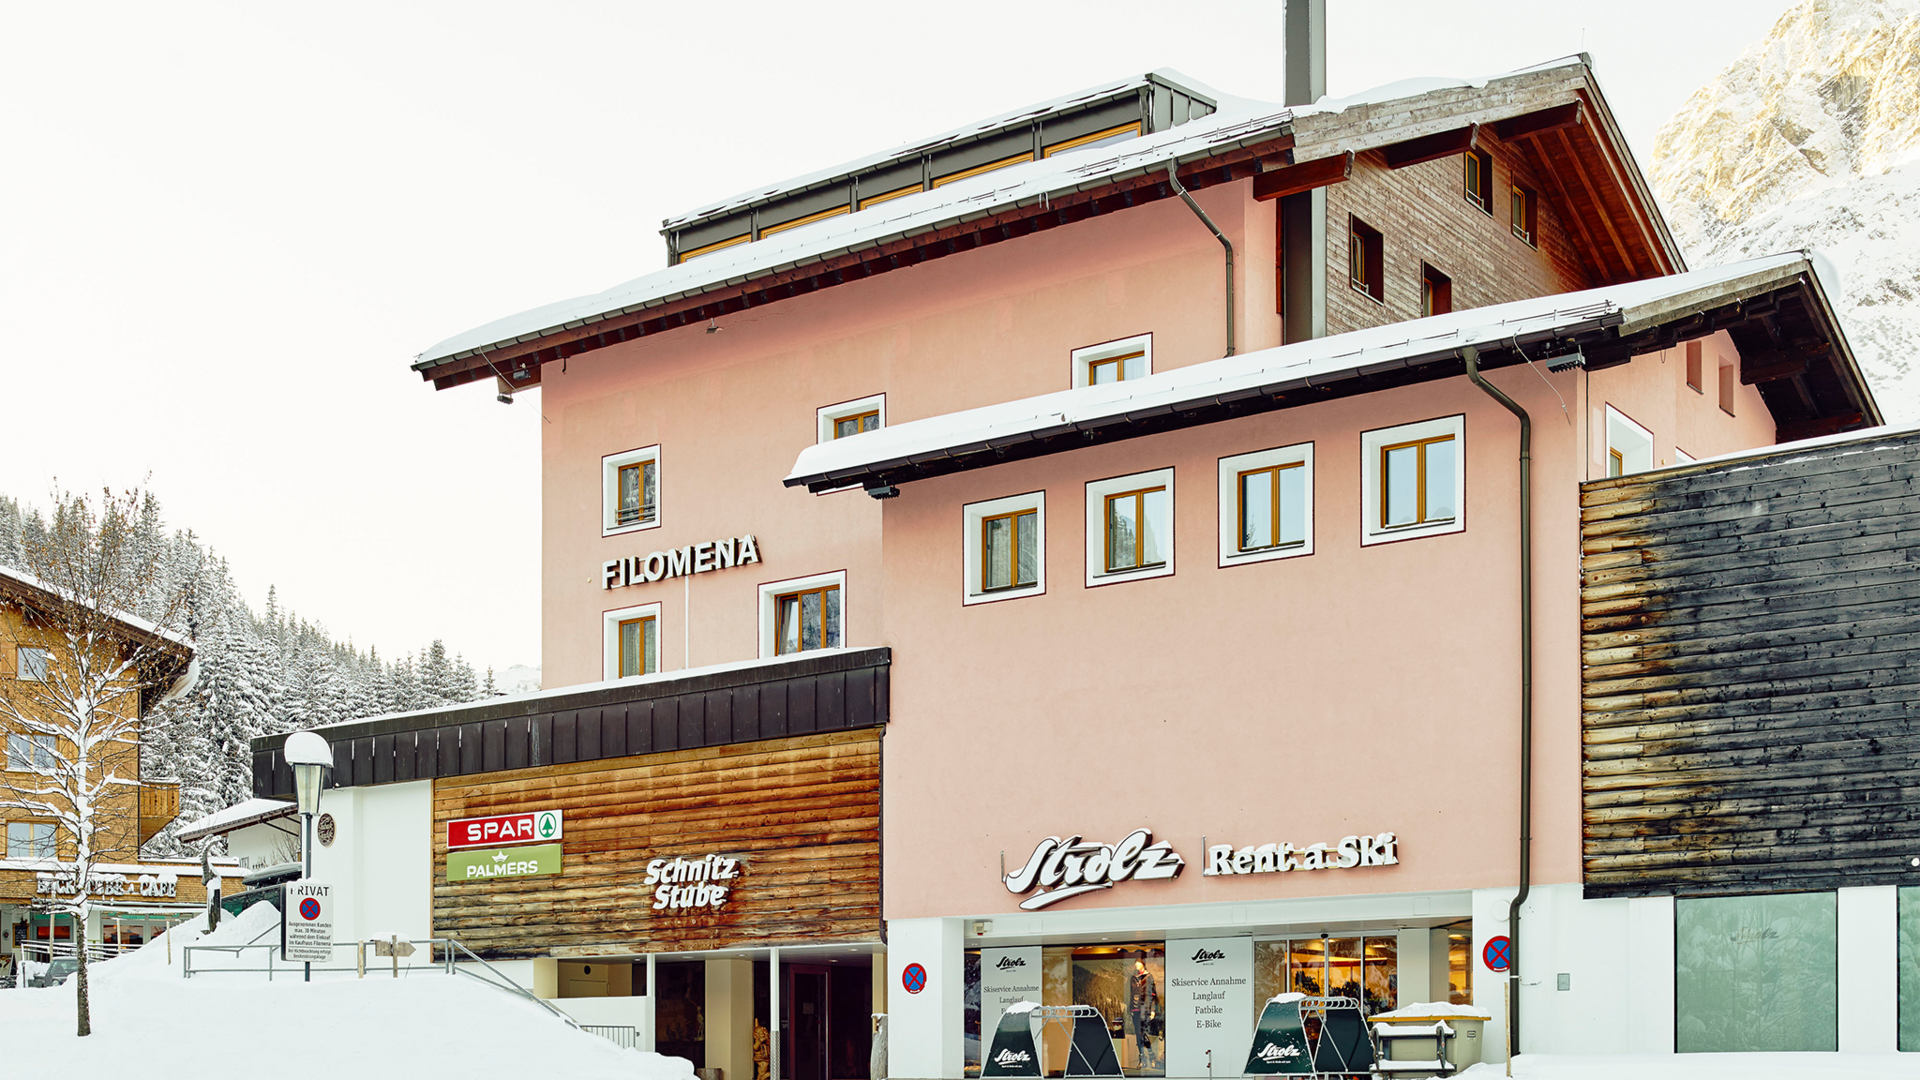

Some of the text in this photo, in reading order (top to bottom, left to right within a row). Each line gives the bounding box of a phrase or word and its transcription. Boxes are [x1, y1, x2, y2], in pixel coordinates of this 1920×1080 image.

[602, 534, 761, 590] FILOMENA
[467, 818, 534, 842] SPAR
[1207, 842, 1294, 875] Rent
[1337, 833, 1398, 869] Ski
[466, 860, 539, 878] PALMERS
[643, 853, 740, 885] Schnitz
[1005, 828, 1186, 901] Strolz
[652, 881, 730, 910] Stube
[995, 955, 1026, 969] Strolz
[1191, 948, 1226, 962] Strolz
[983, 984, 1040, 993] Skiservice Annahme
[1171, 976, 1247, 987] Skiservice Annahme
[999, 996, 1024, 1004] Langlauf
[1192, 991, 1226, 1001] Langlauf
[1195, 1005, 1223, 1015] Fatbike
[1196, 1019, 1222, 1029] E-Bike
[994, 1048, 1031, 1063] Strolz
[1257, 1042, 1300, 1058] Strolz
